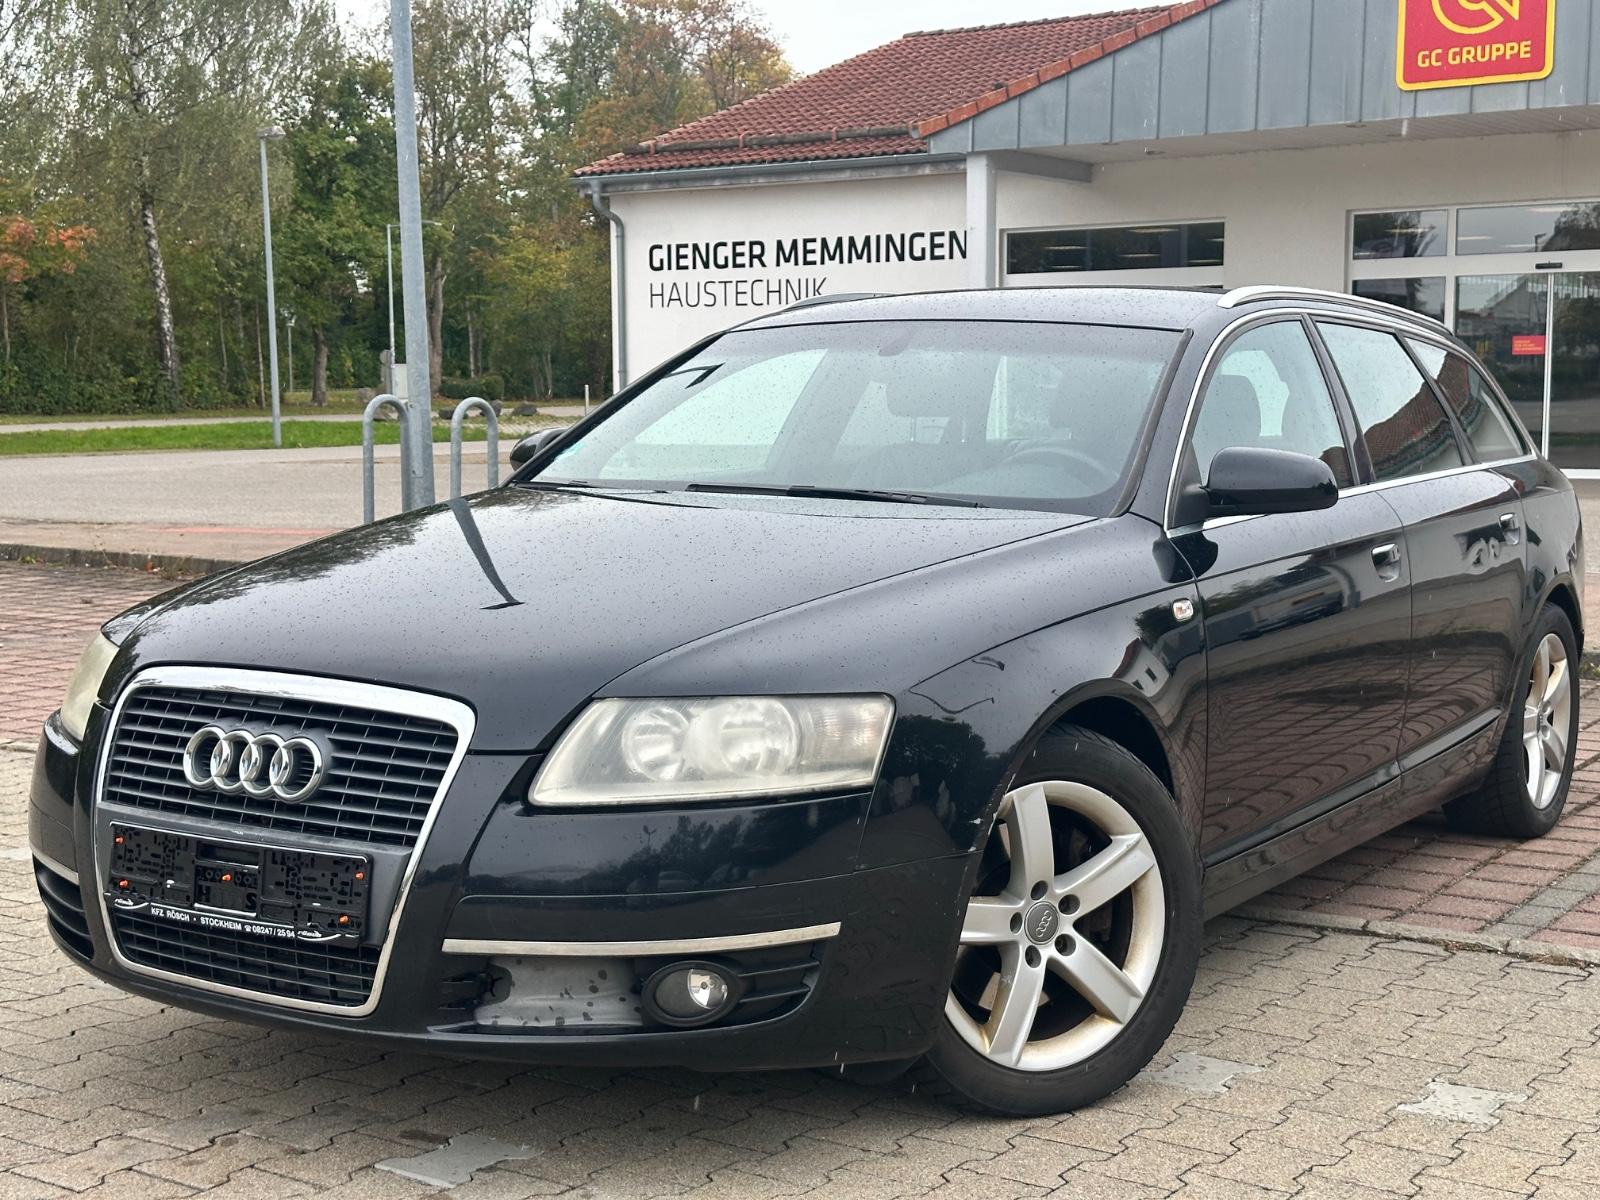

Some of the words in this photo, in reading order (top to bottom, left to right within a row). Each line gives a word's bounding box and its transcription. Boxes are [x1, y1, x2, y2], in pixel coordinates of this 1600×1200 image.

[1417, 49, 1442, 67] GC
[1448, 40, 1531, 65] GRUPPE
[649, 240, 766, 271] GIENGER
[775, 229, 967, 267] MEMMINGEN
[649, 277, 827, 309] HAUSTECHNIK
[150, 906, 165, 917] KFZ
[166, 908, 190, 922] RÖSCH
[200, 916, 242, 931] STOCKHEIM
